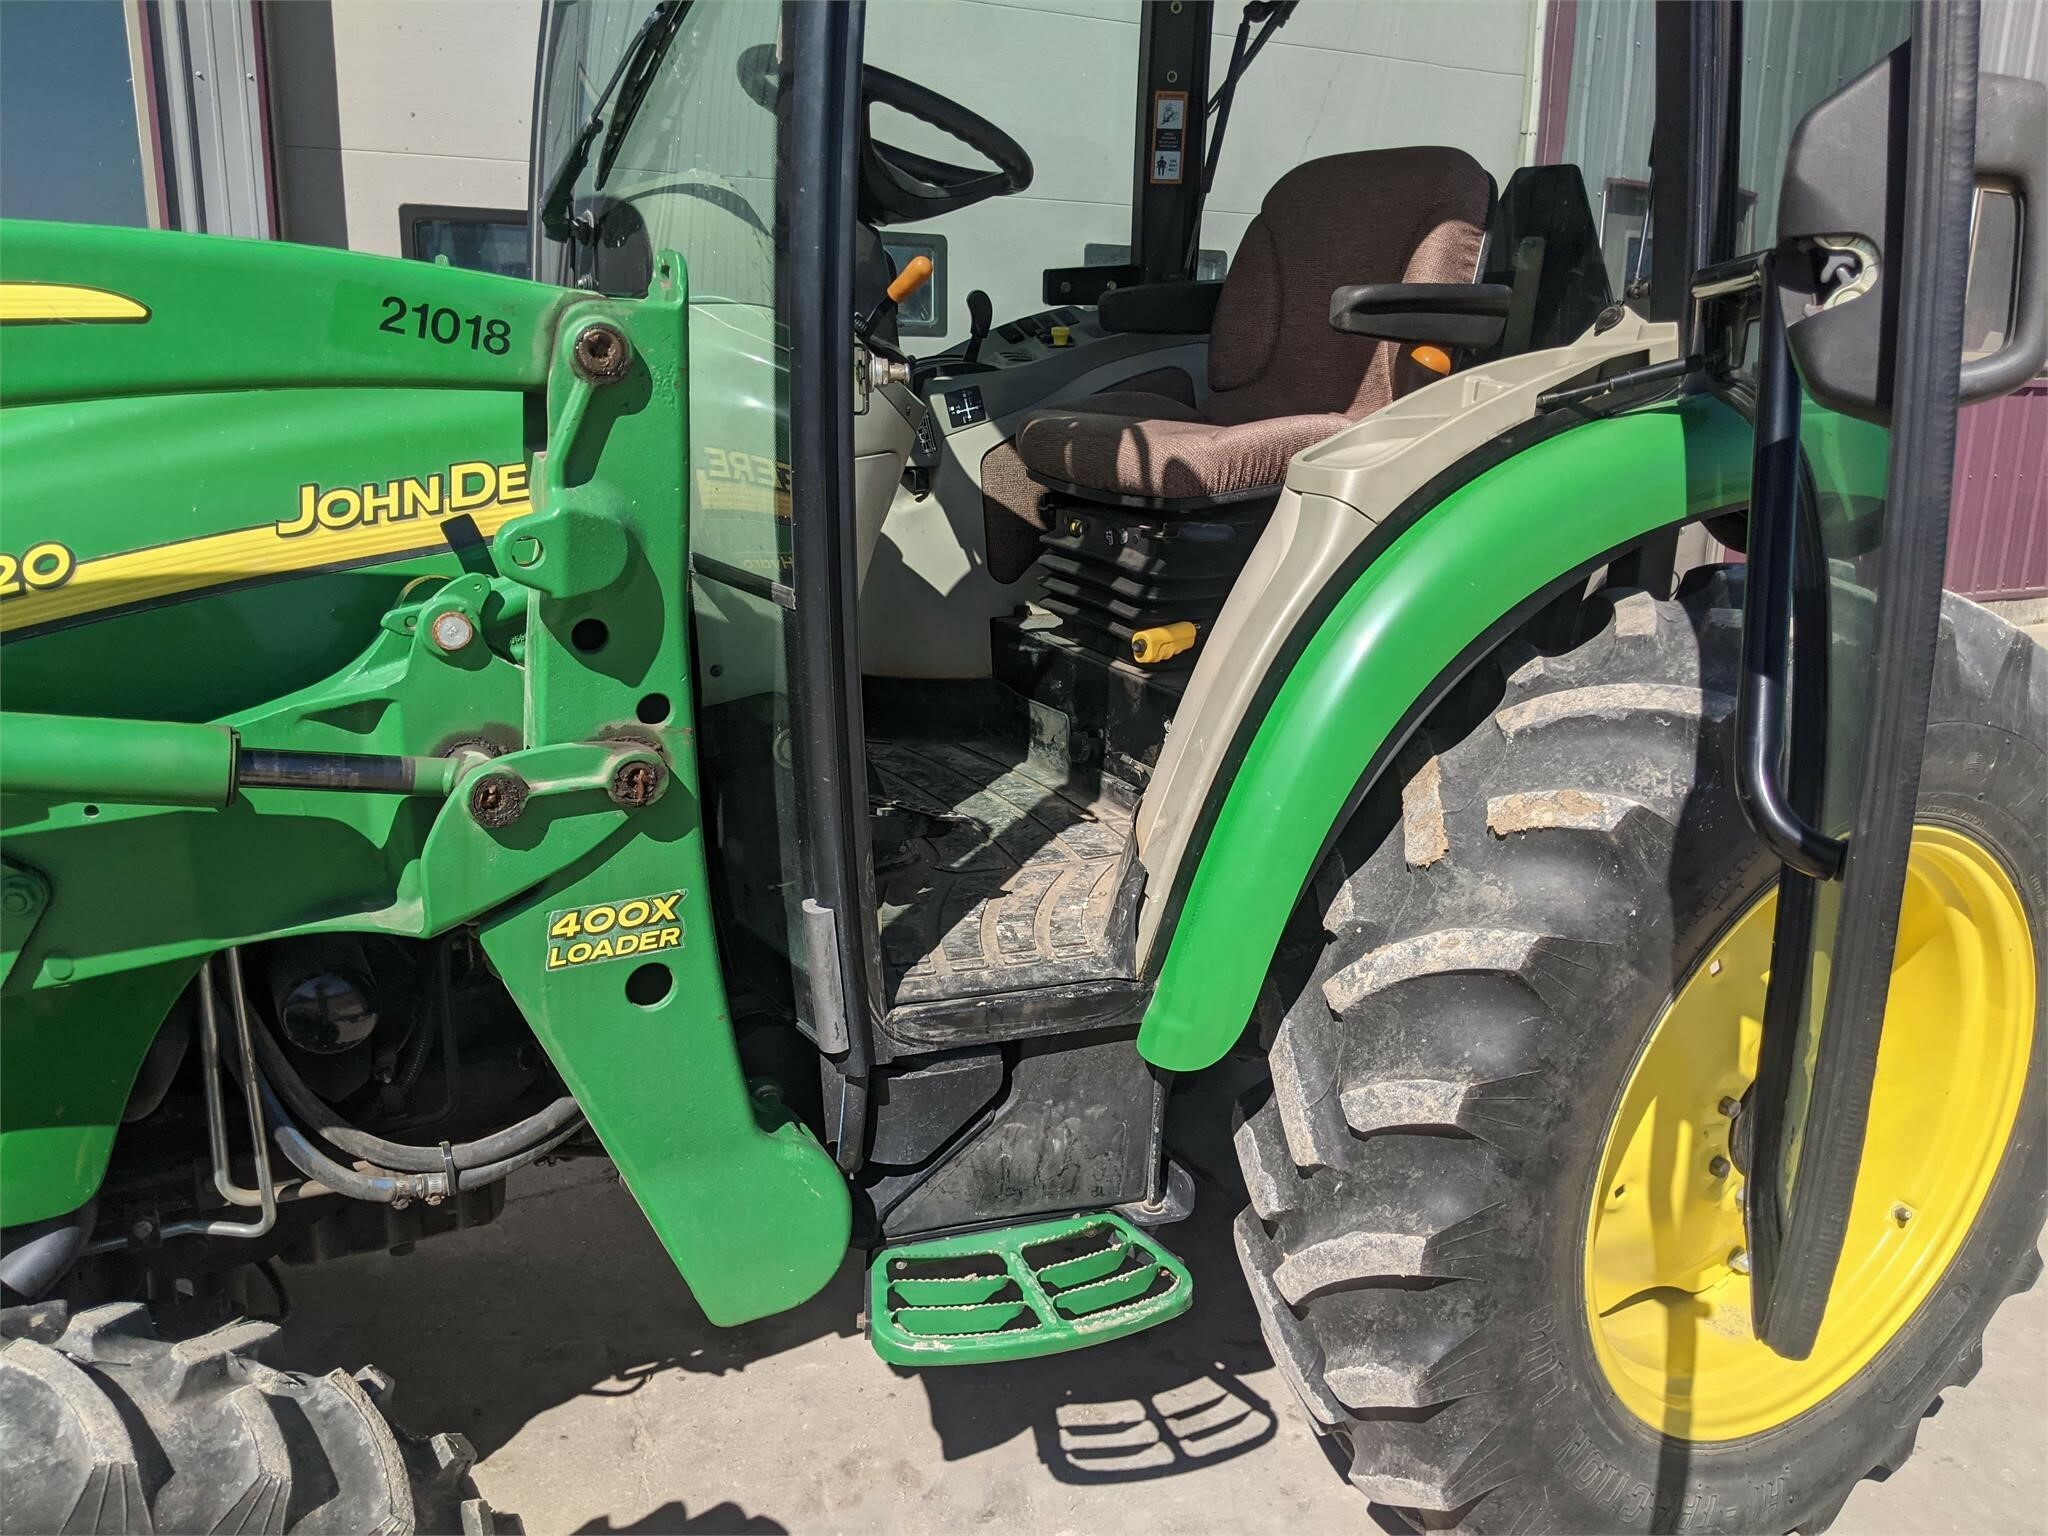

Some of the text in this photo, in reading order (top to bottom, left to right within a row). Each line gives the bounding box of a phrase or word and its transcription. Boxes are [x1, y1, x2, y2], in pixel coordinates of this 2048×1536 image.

[379, 296, 511, 355] 21018
[550, 893, 685, 940] 400X
[548, 926, 683, 970] LOADER
